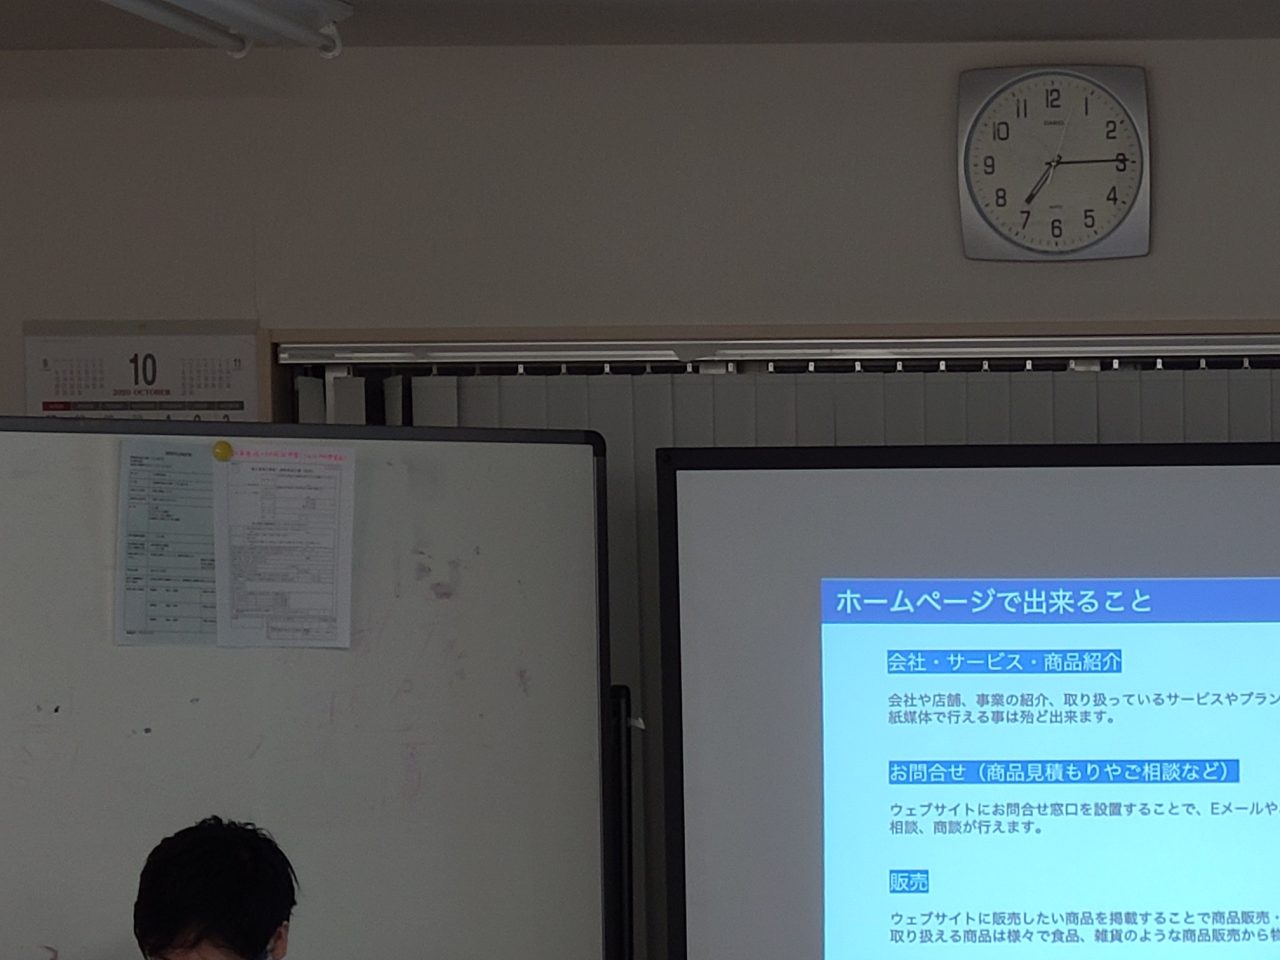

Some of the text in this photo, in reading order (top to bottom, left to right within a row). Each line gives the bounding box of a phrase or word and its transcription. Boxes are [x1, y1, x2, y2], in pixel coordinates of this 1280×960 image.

[1016, 98, 1028, 118] 11
[1045, 88, 1061, 108] 12
[992, 121, 1010, 141] 10
[1105, 120, 1117, 139] 2
[983, 155, 995, 175] 9
[1115, 153, 1127, 172] 3
[995, 188, 1007, 207] 8
[1106, 186, 1119, 205] 4
[1019, 210, 1031, 230] 7
[1051, 219, 1063, 238] 6
[1084, 209, 1095, 229] 5
[129, 352, 157, 386] 10
[233, 358, 242, 368] 11
[133, 388, 171, 396] OCTOBER
[836, 587, 1153, 615] ホームページで出来ること
[888, 651, 1122, 673] 会社・サービス・商品紹介
[888, 709, 1115, 725] 紙媒体で行える事は殆ど出来ます。
[889, 819, 1042, 835] 相談、商談が行えます。
[889, 872, 929, 893] 販売
